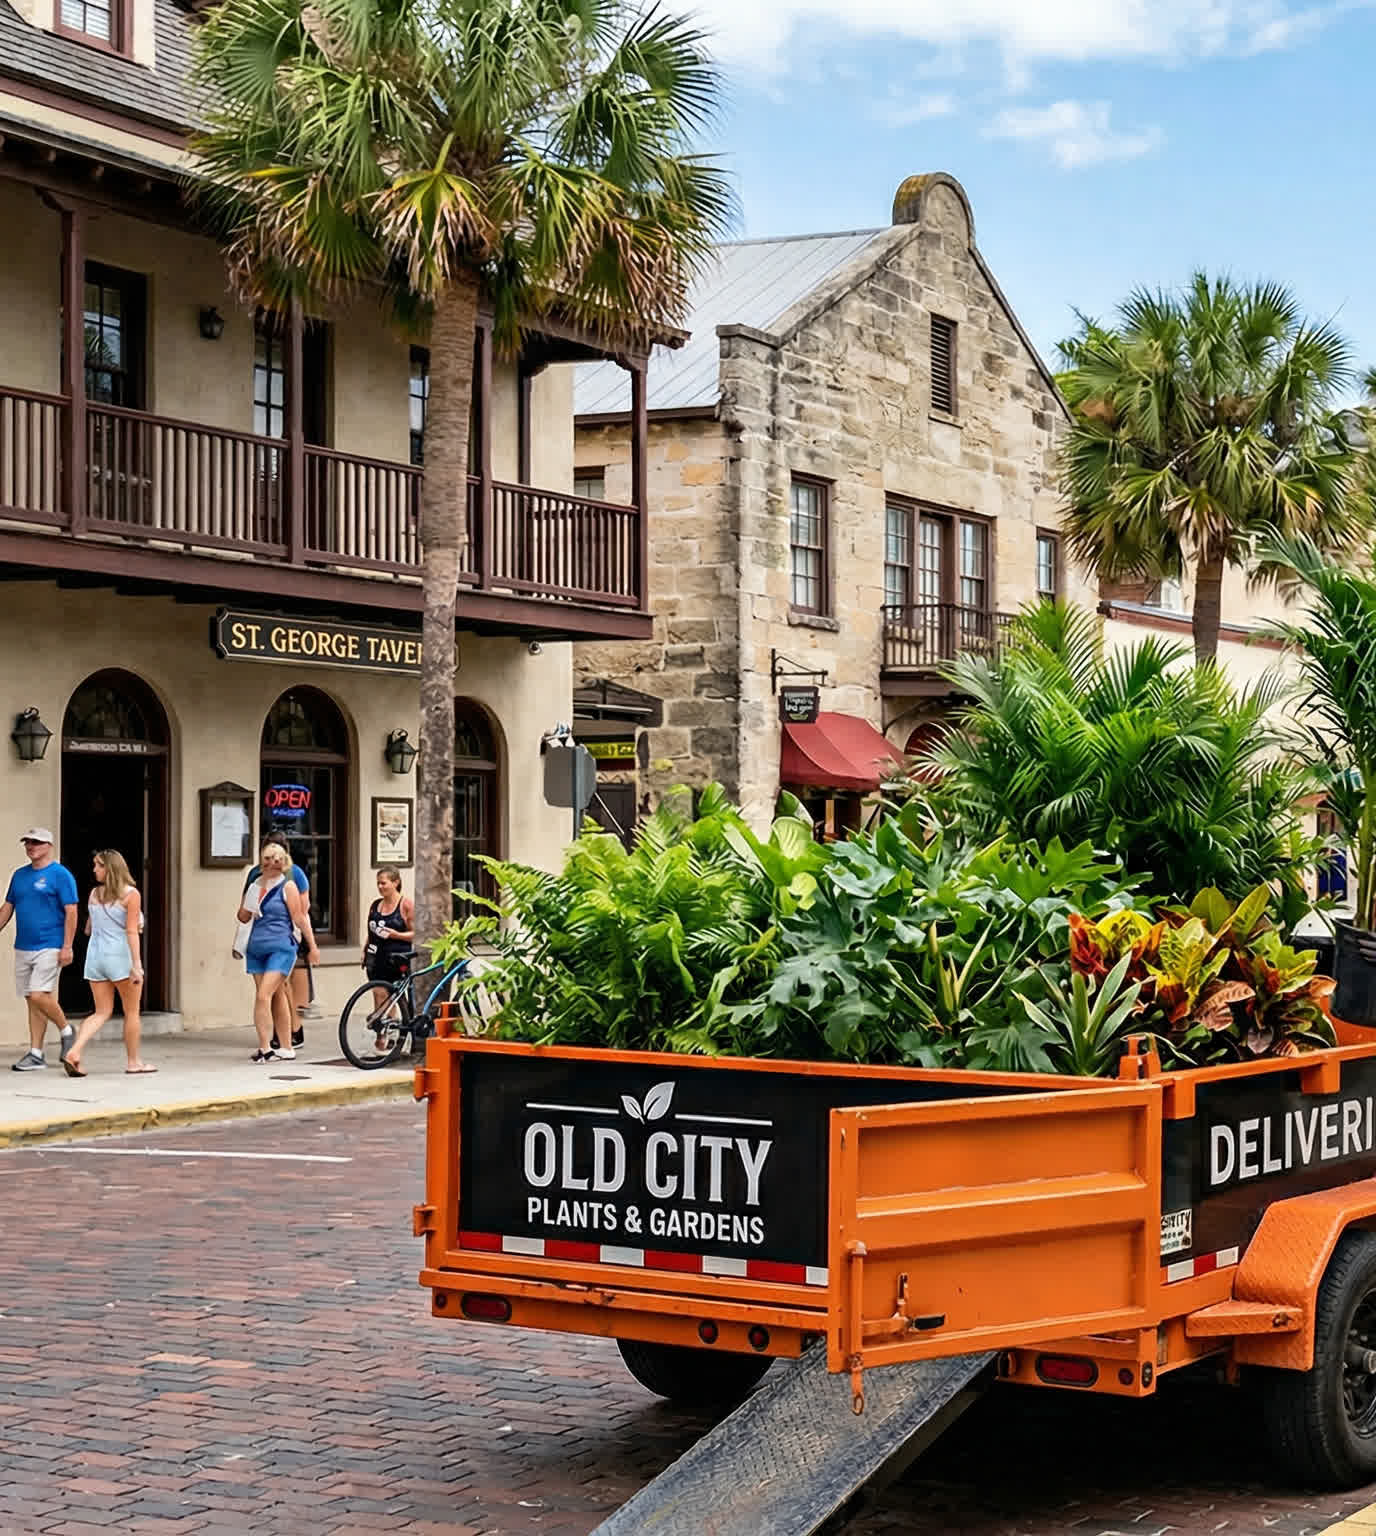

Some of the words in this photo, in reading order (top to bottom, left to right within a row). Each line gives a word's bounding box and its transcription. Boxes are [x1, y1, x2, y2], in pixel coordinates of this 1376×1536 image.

[231, 623, 265, 650] ST.
[271, 626, 360, 659] GEORGE
[367, 637, 423, 665] TAVE
[264, 789, 311, 809] OPEN
[524, 1122, 626, 1192] OLD
[645, 1131, 773, 1206] CITY
[527, 1196, 617, 1231] PLANTS
[624, 1205, 642, 1233] &
[650, 1207, 765, 1245] GARDENS
